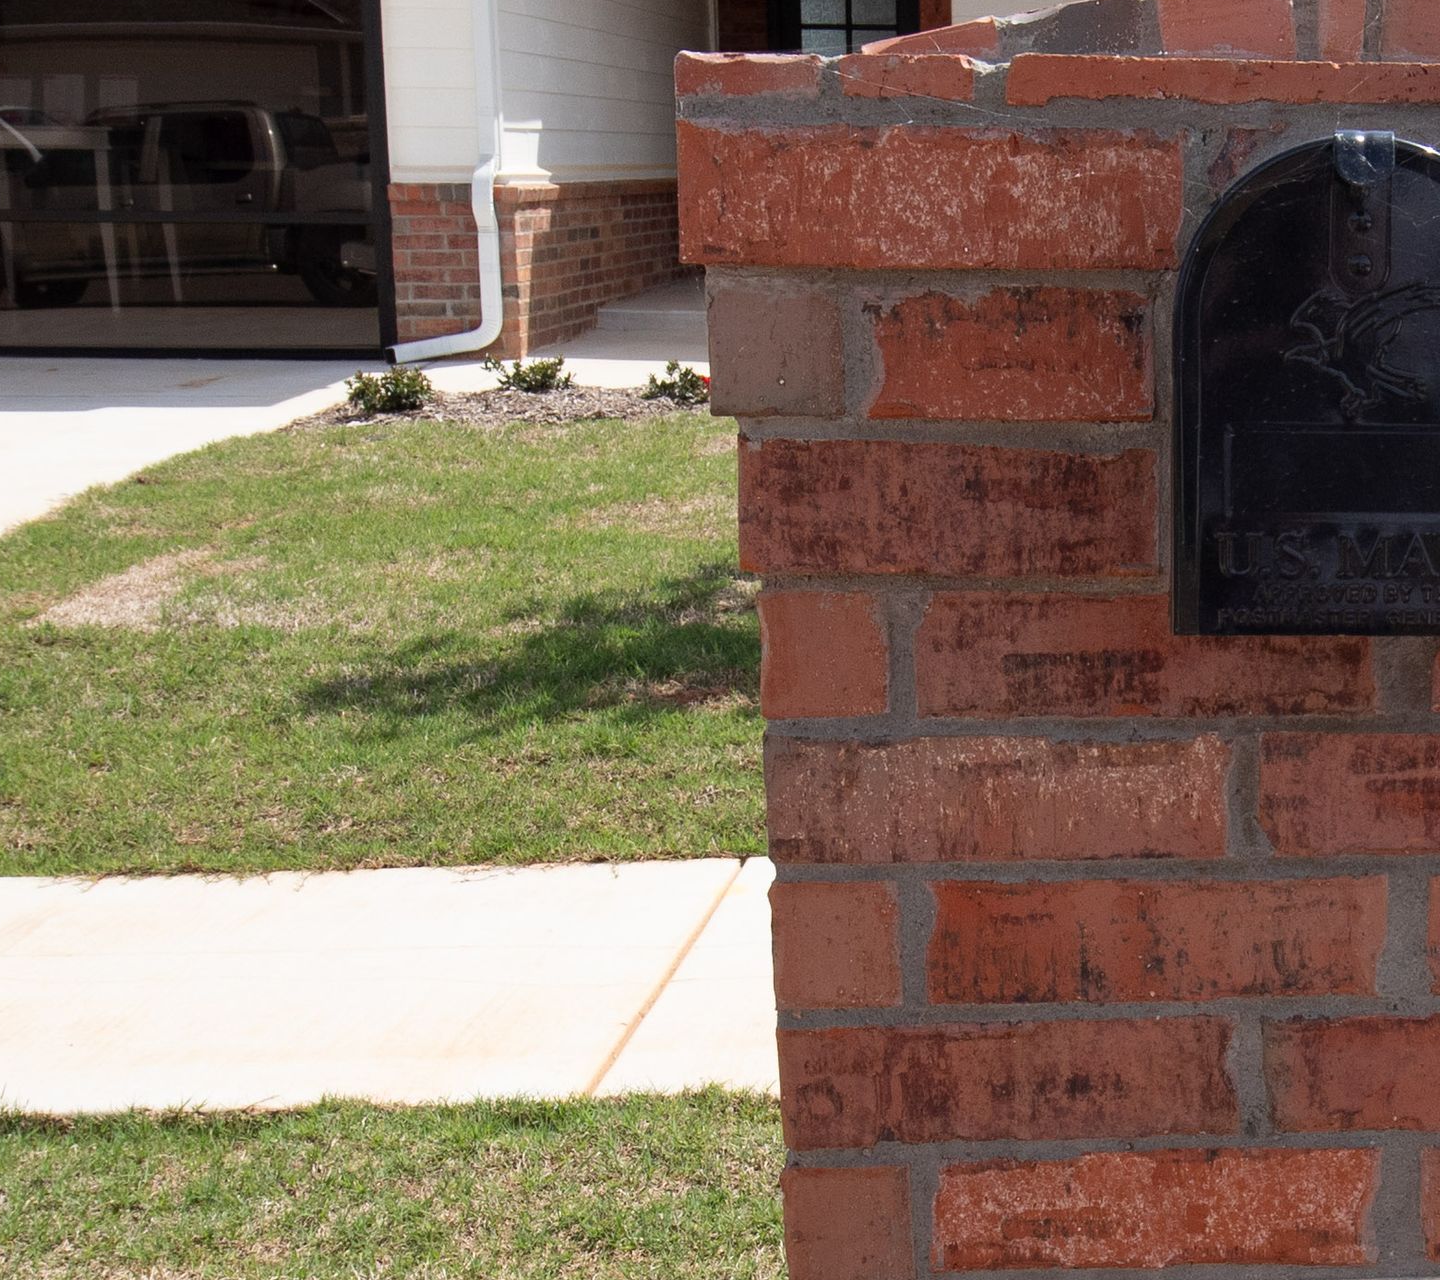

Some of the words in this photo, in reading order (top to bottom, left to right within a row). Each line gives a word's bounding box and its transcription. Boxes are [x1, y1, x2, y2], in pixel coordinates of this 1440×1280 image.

[1213, 529, 1320, 579] U.S.
[1252, 584, 1377, 605] APPROVED
[1384, 584, 1413, 604] BY
[1217, 606, 1373, 627] POSTMASTER
